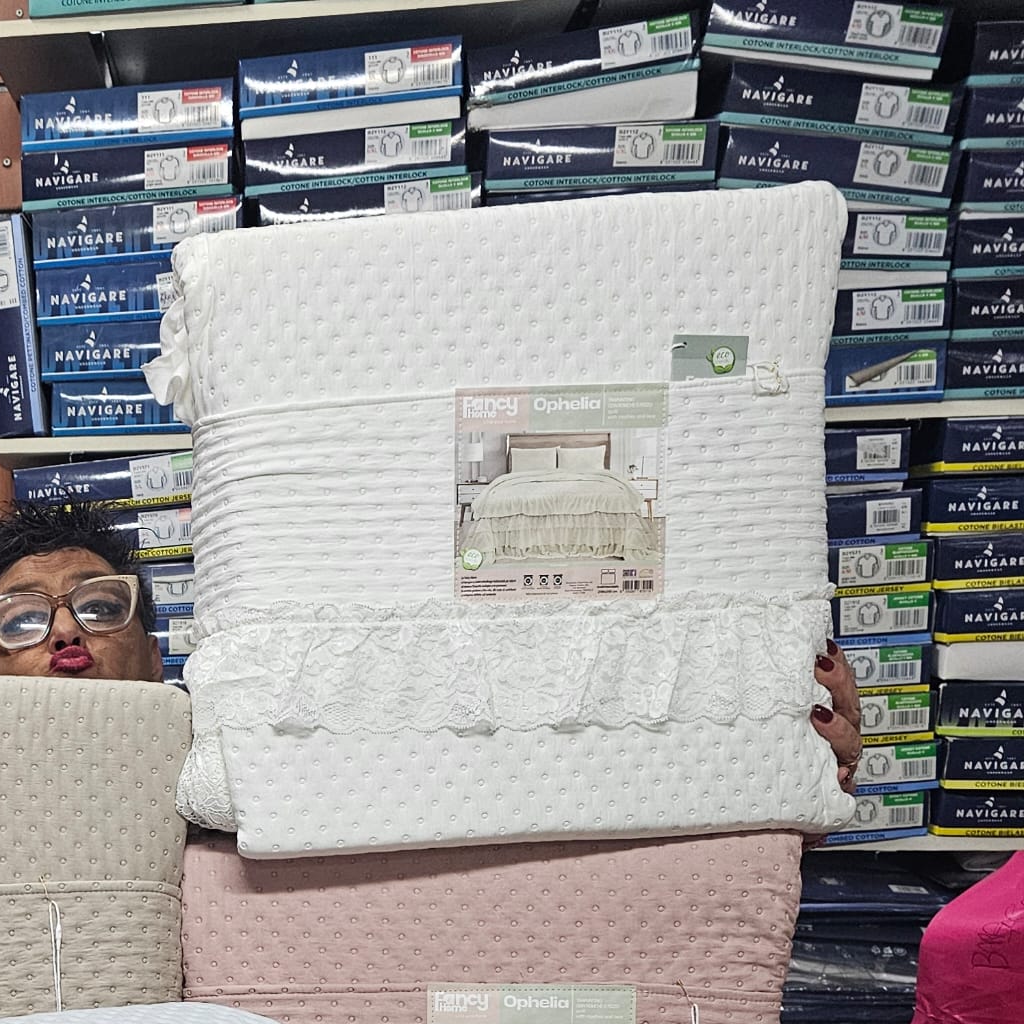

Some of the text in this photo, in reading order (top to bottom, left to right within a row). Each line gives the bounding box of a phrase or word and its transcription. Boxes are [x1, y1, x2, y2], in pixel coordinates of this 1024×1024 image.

[742, 38, 899, 61] COTONE INTERLOCK/COTTON INTERLOCK
[483, 60, 553, 81] NAVIGARE
[507, 68, 662, 100] COTONE INTERLOCK/COTTON INTERLOCK
[742, 89, 813, 105] NAVIGARE
[760, 117, 913, 140] COTONE INTERLOCK/COTTON INTERLOCK
[503, 154, 572, 166] NAVIGARE
[738, 155, 809, 171] NAVIGARE
[35, 172, 99, 188] NAVIGARE
[281, 171, 427, 192] COTONE INTERLOCK/COTTON INTERLOCK
[523, 174, 676, 187] COTONE INTERLOCK/COTTON INTERLOCK
[57, 189, 198, 207] COTONE INTERLOCK/COTTON INTERLOCK
[867, 193, 911, 203] INTERLOCK
[47, 231, 124, 249] NAVIGARE
[868, 261, 911, 269] INTERLOCK
[17, 257, 25, 288] COTTON
[50, 290, 126, 306] NAVIGARE
[971, 304, 1024, 315] NAVIGA
[868, 333, 909, 343] INTERLOCK
[55, 347, 131, 362] NAVIGARE
[29, 364, 37, 392] COTONE
[7, 355, 23, 421] NAVIGARE
[984, 389, 1014, 397] COTONE
[67, 403, 143, 417] NAVIGARE
[462, 395, 519, 418] Fancy
[533, 396, 601, 413] Ophelia
[467, 408, 497, 418] Home
[962, 441, 1024, 452] NAVIGAR
[835, 474, 865, 482] COTTON
[142, 497, 170, 505] COTTON
[948, 500, 1019, 512] NAVIGARE
[958, 523, 992, 531] COTONE
[151, 548, 179, 557] COTTON
[955, 557, 1024, 569] NAVIGARE
[965, 580, 999, 588] COTONE
[844, 586, 876, 595] COTTON
[859, 637, 888, 645] COTTON
[976, 634, 1007, 642] COTONE
[876, 687, 904, 695] JERSEY
[959, 707, 1024, 719] NAVIGA
[880, 735, 908, 743] JERSEY
[868, 785, 898, 794] COTTON
[956, 808, 1024, 819] NAVIGARE
[856, 832, 886, 842] COTTON
[965, 829, 997, 837] COTONE
[434, 991, 489, 1012] Fancy
[503, 995, 569, 1011] Ophelia
